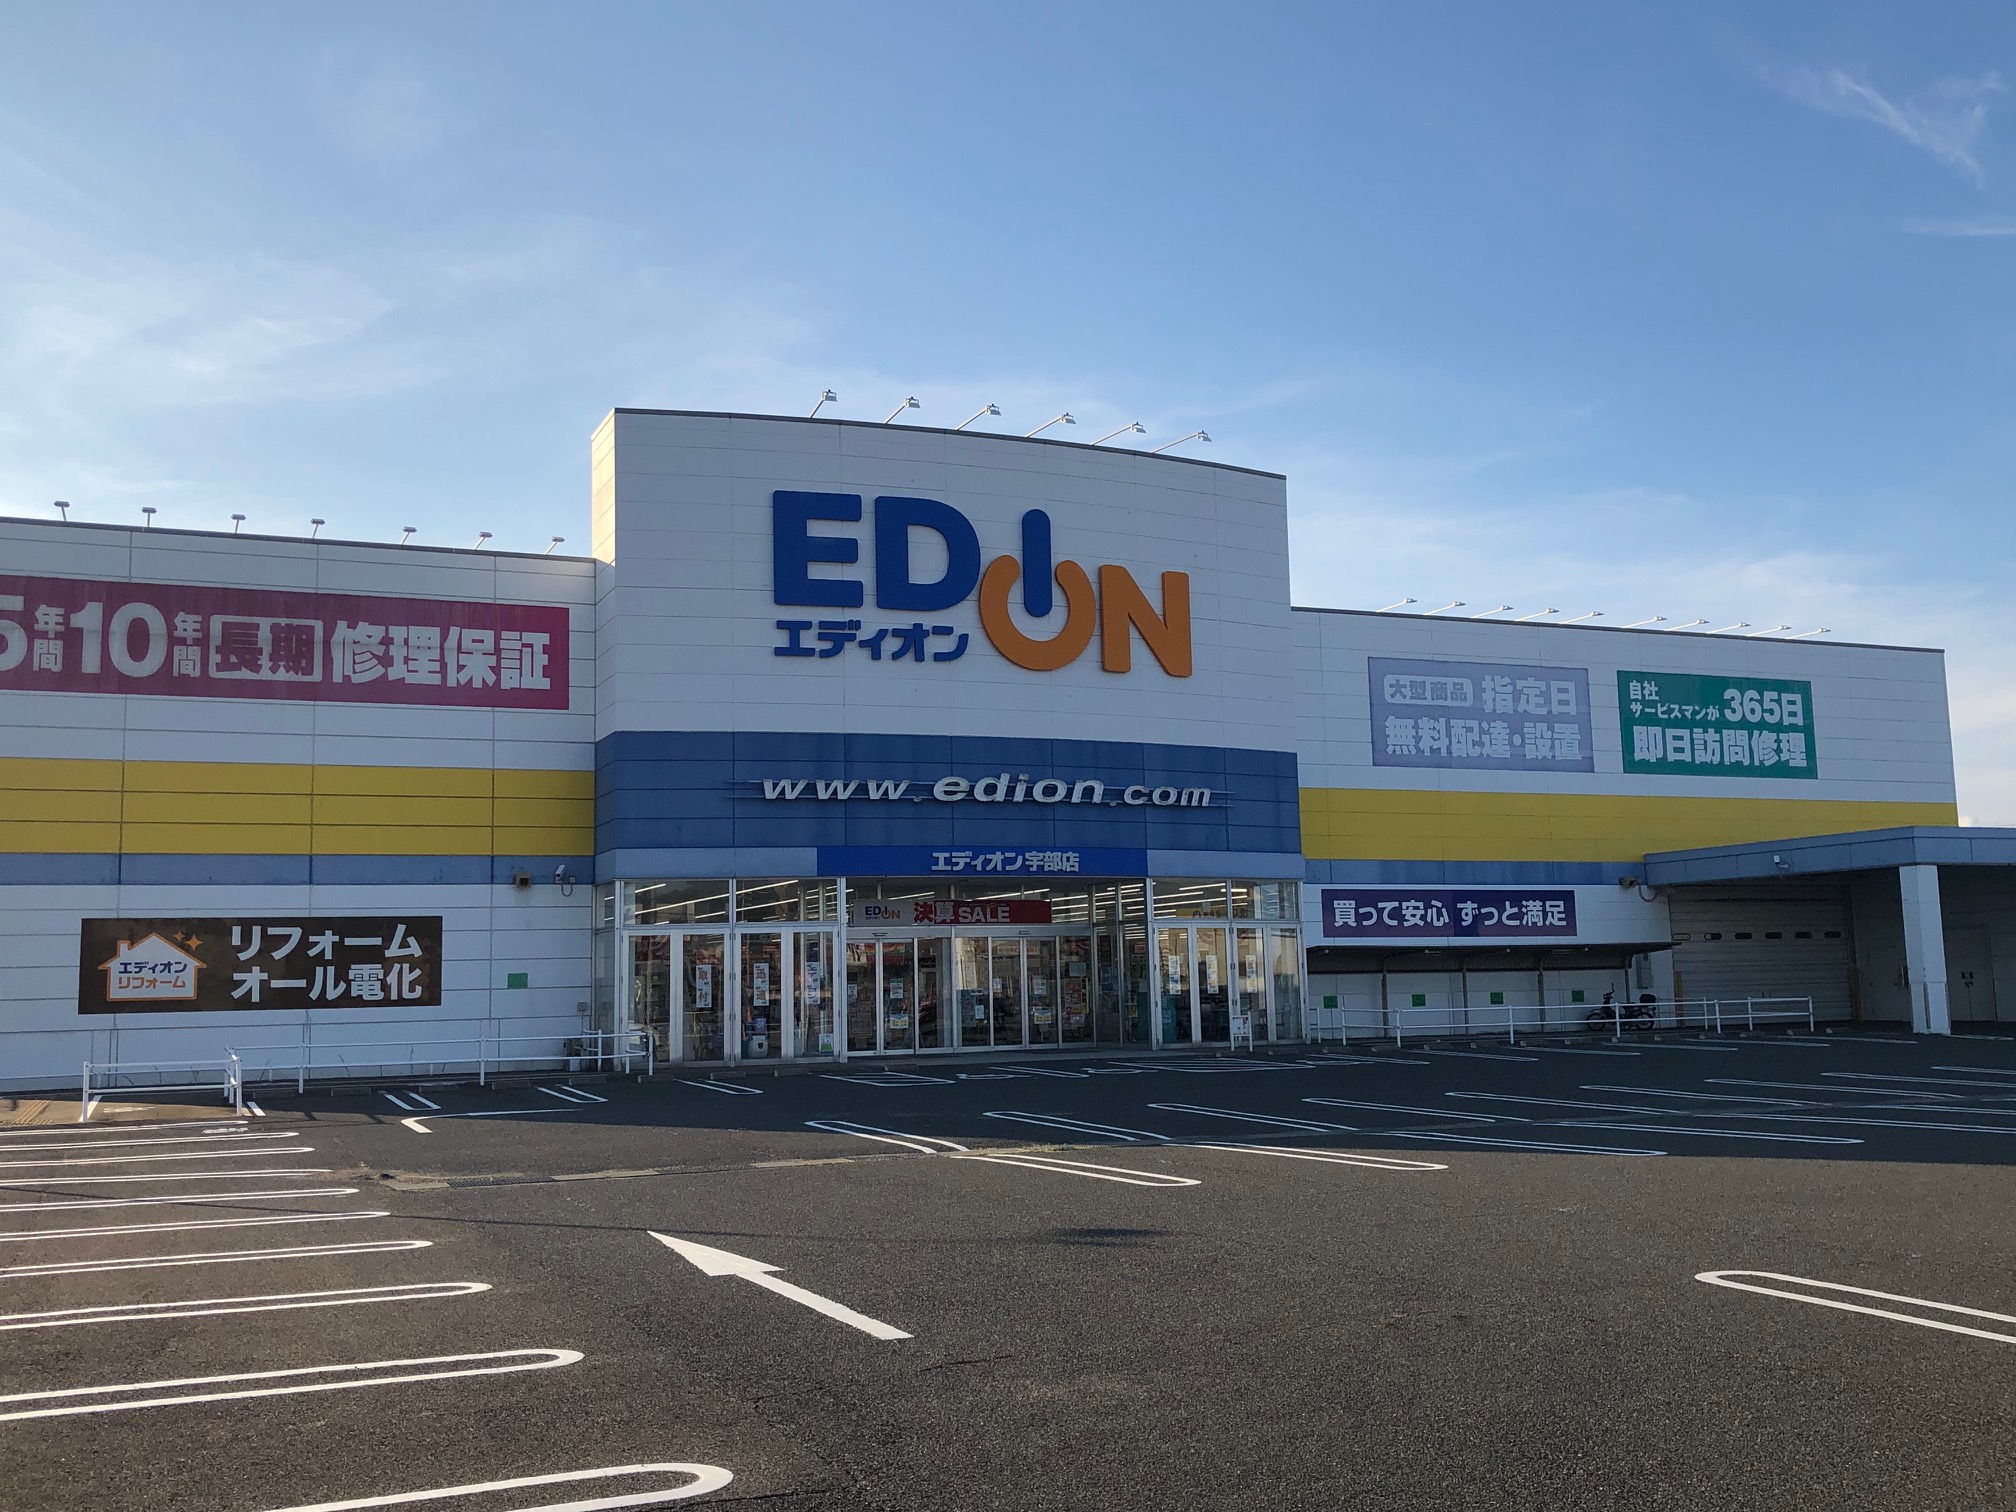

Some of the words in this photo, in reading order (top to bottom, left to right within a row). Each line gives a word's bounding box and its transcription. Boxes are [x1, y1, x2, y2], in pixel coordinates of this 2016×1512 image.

[773, 490, 1193, 677] EDION
[774, 619, 969, 662] エディオン
[1629, 679, 1659, 700] 自社
[1630, 701, 1720, 721] サービスマンが
[1723, 688, 1804, 726] 365日
[1632, 725, 1808, 768] 即日訪問修理
[762, 773, 1212, 808] www.edion.com
[865, 905, 901, 920] EDION
[958, 906, 1011, 923] SALE
[1333, 899, 1450, 928] 買って安心
[1456, 899, 1567, 928] ずっと満足
[230, 923, 423, 962] リフォーム
[118, 961, 187, 975] エディオン
[118, 975, 187, 990] リフォーム
[230, 962, 423, 1004] オール電化
